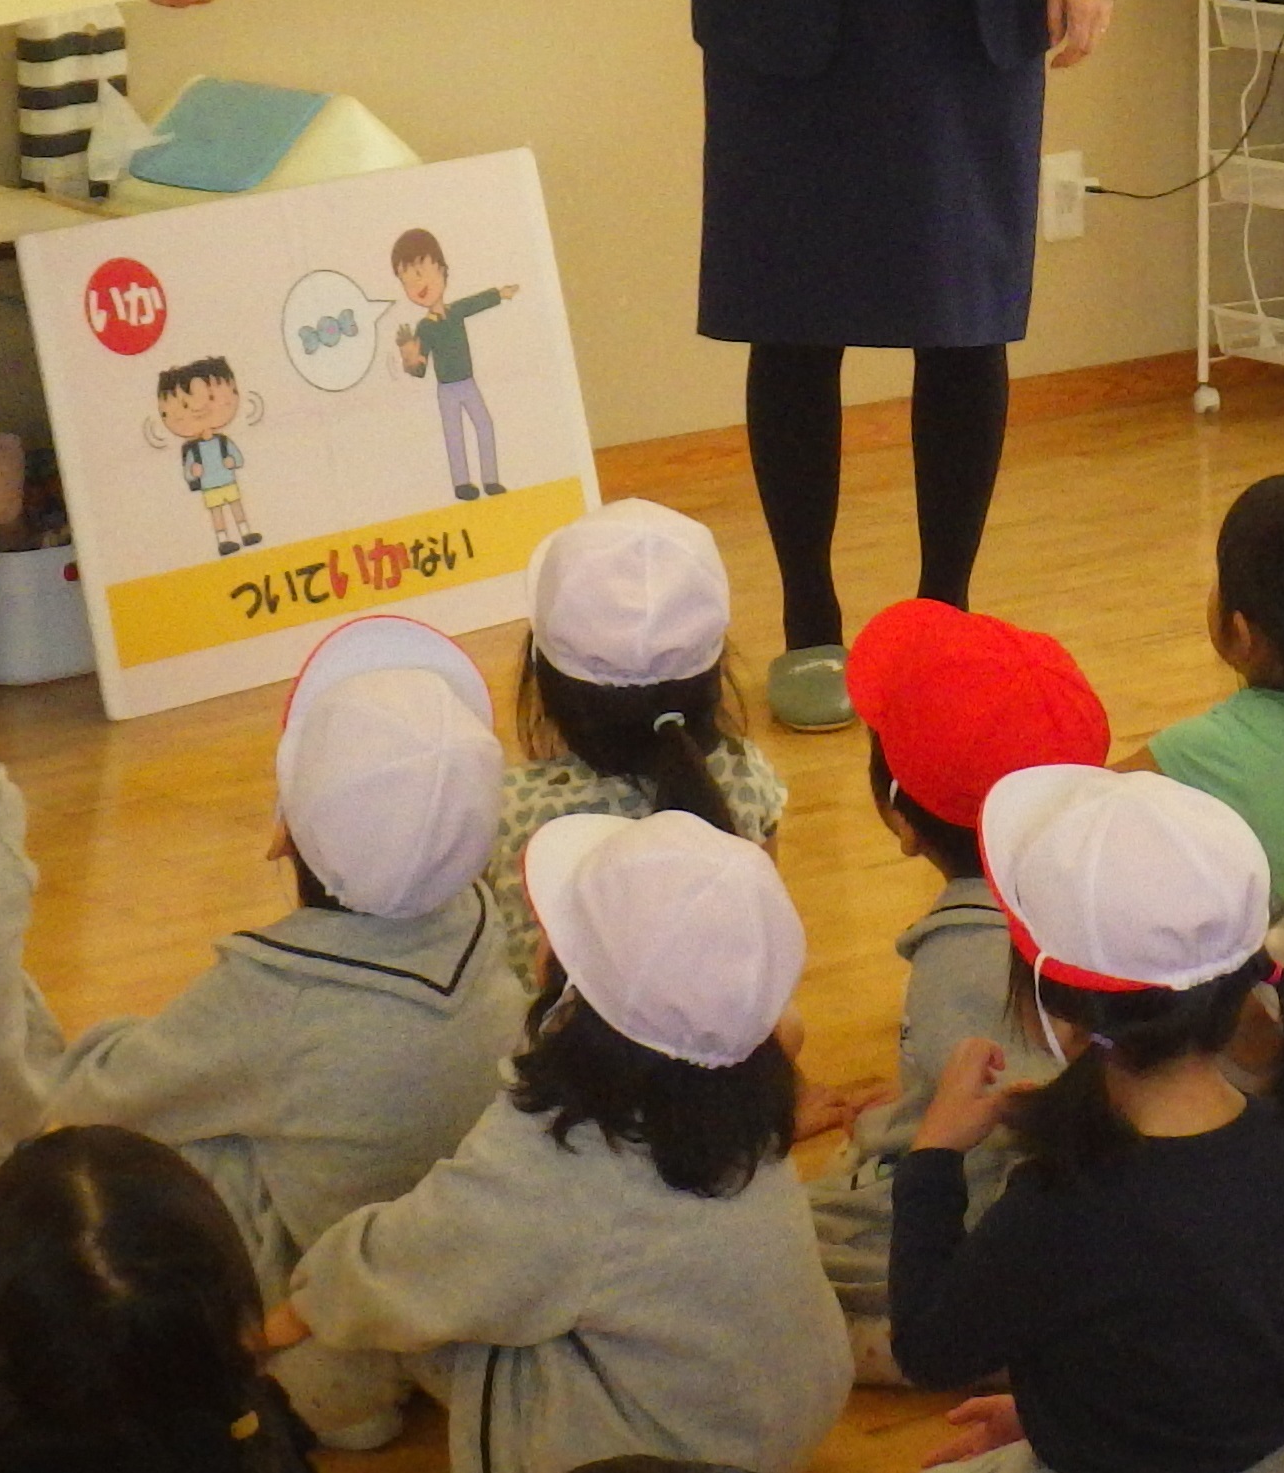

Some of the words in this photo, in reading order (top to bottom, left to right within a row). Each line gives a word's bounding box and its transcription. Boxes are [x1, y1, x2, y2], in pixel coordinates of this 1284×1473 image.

[89, 282, 164, 332] いか
[230, 528, 475, 619] ついていかない
